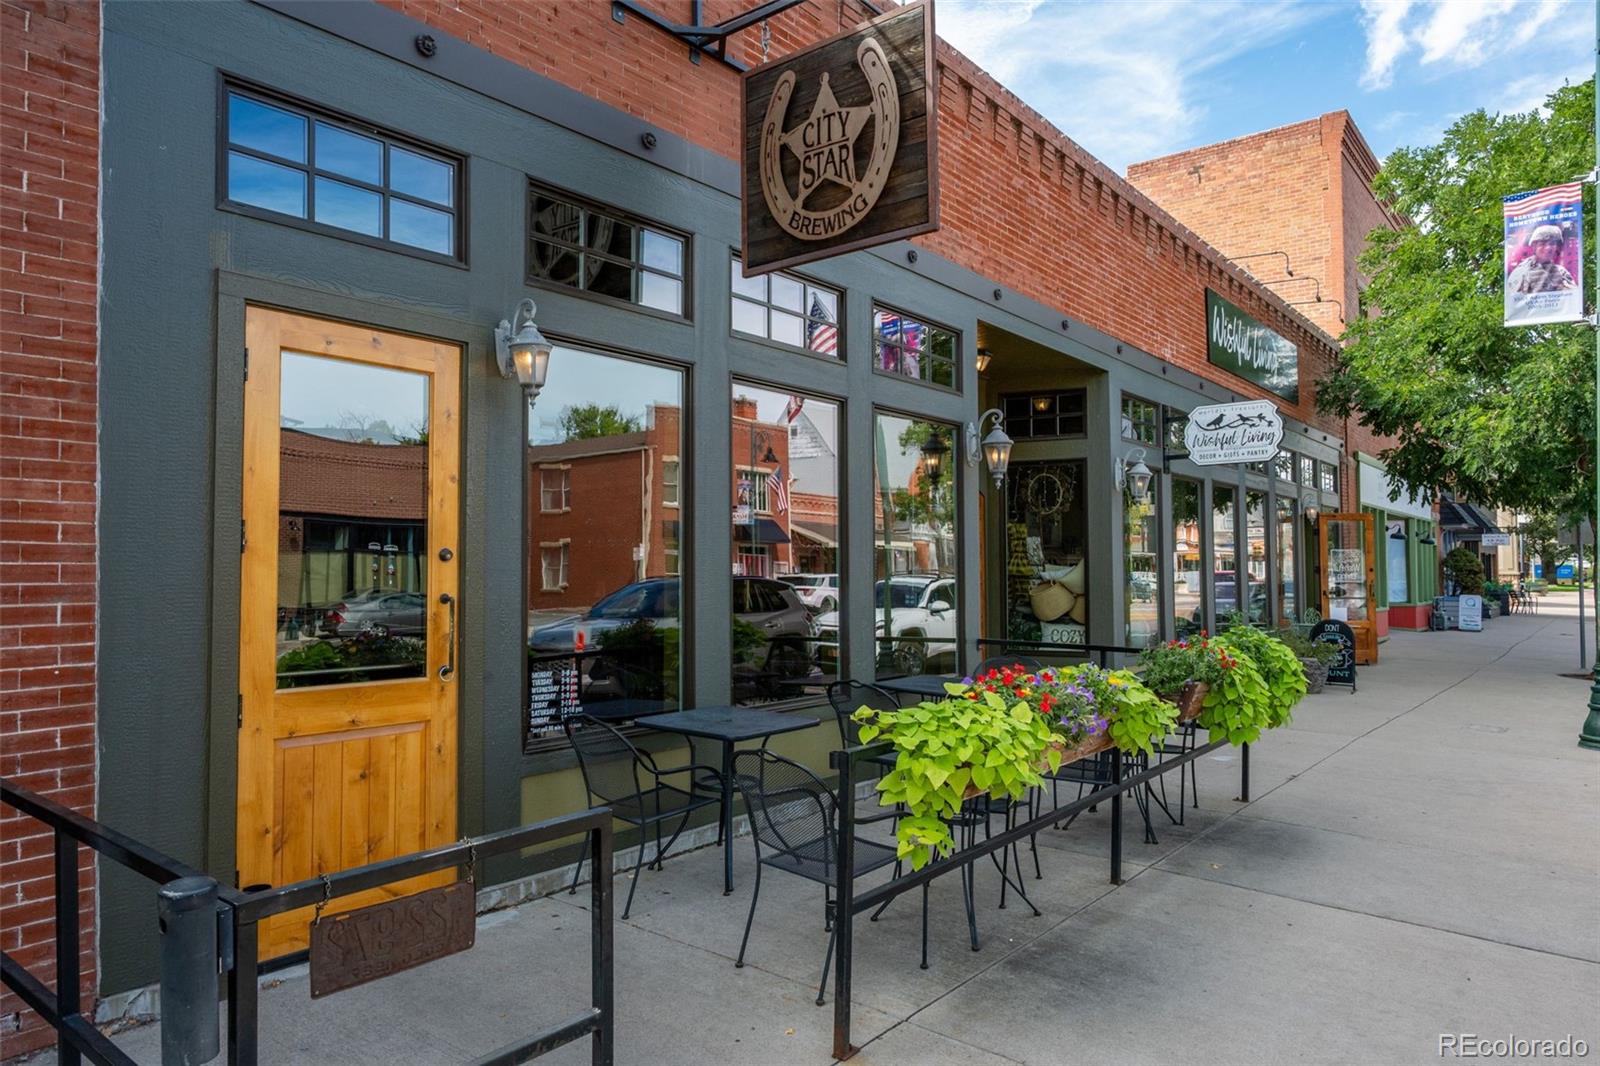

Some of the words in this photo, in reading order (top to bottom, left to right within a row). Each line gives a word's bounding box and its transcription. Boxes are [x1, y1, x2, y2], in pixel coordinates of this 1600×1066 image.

[803, 110, 850, 148] CITY
[802, 144, 851, 189] STAR
[788, 193, 869, 236] BREWING
[1549, 211, 1578, 220] HEROES
[1212, 305, 1252, 366] Wishful
[1253, 327, 1278, 380] Living
[1192, 429, 1237, 451] Wishful
[1240, 428, 1275, 447] Living
[532, 685, 560, 694] WEDNESDAY
[532, 693, 556, 701] THURSDAY
[531, 708, 556, 717] SATURDAY
[531, 716, 550, 725] SUNDAY
